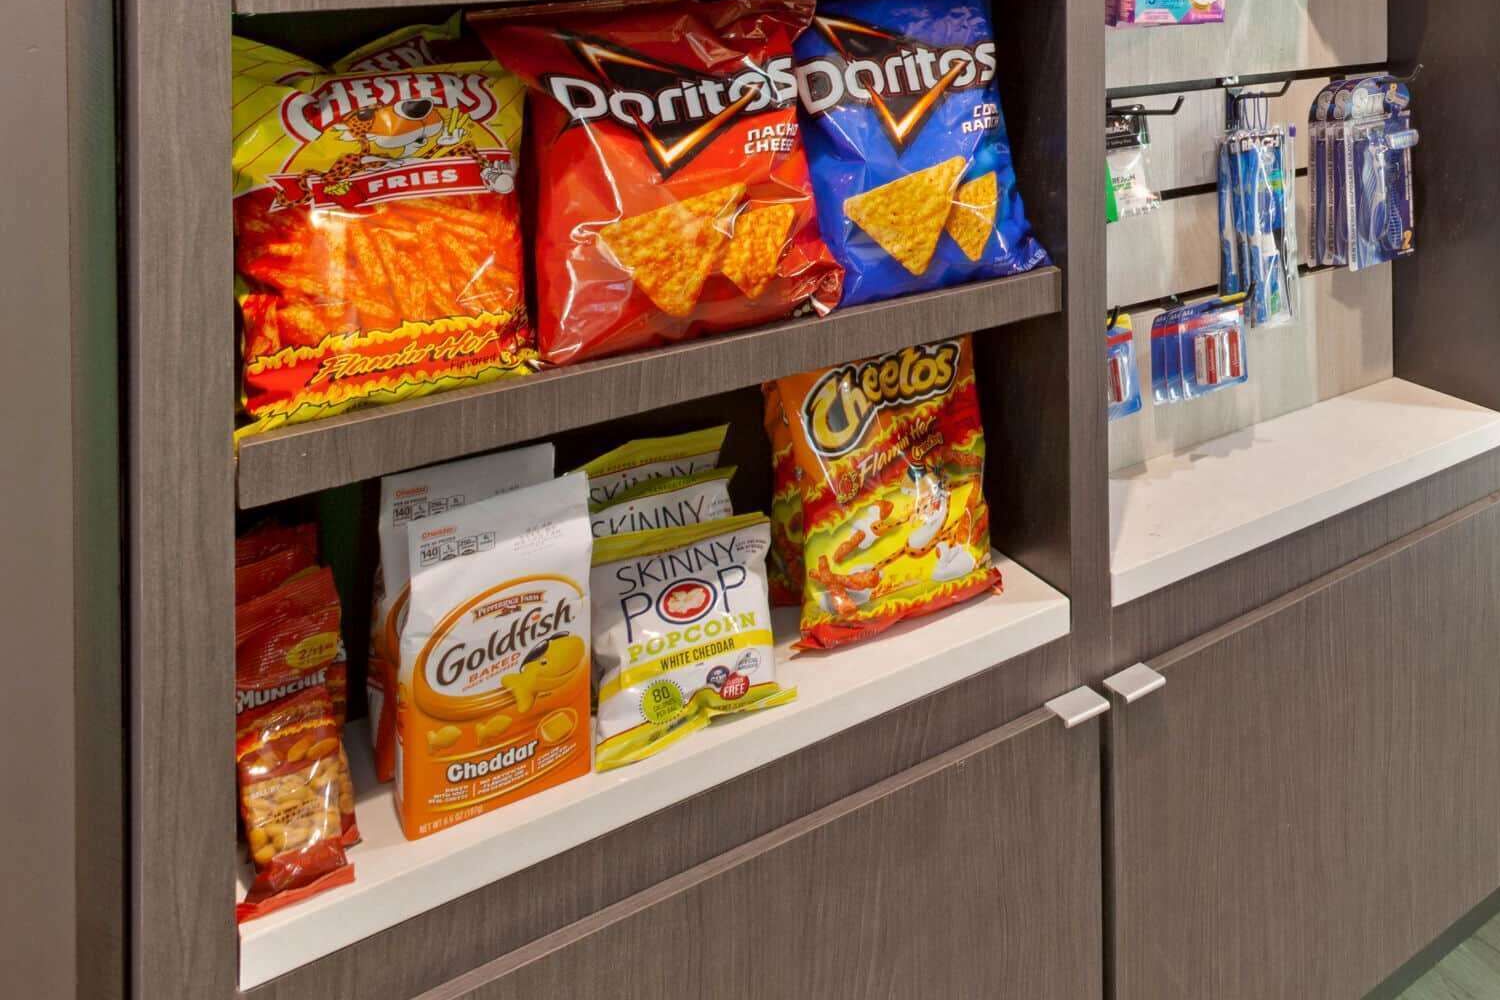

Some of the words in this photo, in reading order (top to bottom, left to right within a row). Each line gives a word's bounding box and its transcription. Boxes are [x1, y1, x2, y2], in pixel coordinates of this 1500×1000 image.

[549, 57, 799, 125] Doritos
[798, 42, 997, 115] Doritos
[367, 168, 459, 194] FRIES
[806, 341, 957, 455] Cheetos
[394, 506, 411, 519] 140
[421, 548, 439, 560] 140
[616, 536, 736, 596] SKINNY
[620, 564, 746, 643] POP
[436, 597, 571, 686] Goldfish
[628, 610, 757, 664] POPCORN
[660, 652, 691, 672] WHITE
[692, 637, 736, 661] CHEDDAR
[236, 667, 328, 714] MUNCHIE
[468, 652, 521, 683] BAKED
[723, 683, 746, 697] FREE
[653, 686, 671, 703] 80
[447, 738, 539, 783] Cheddar
